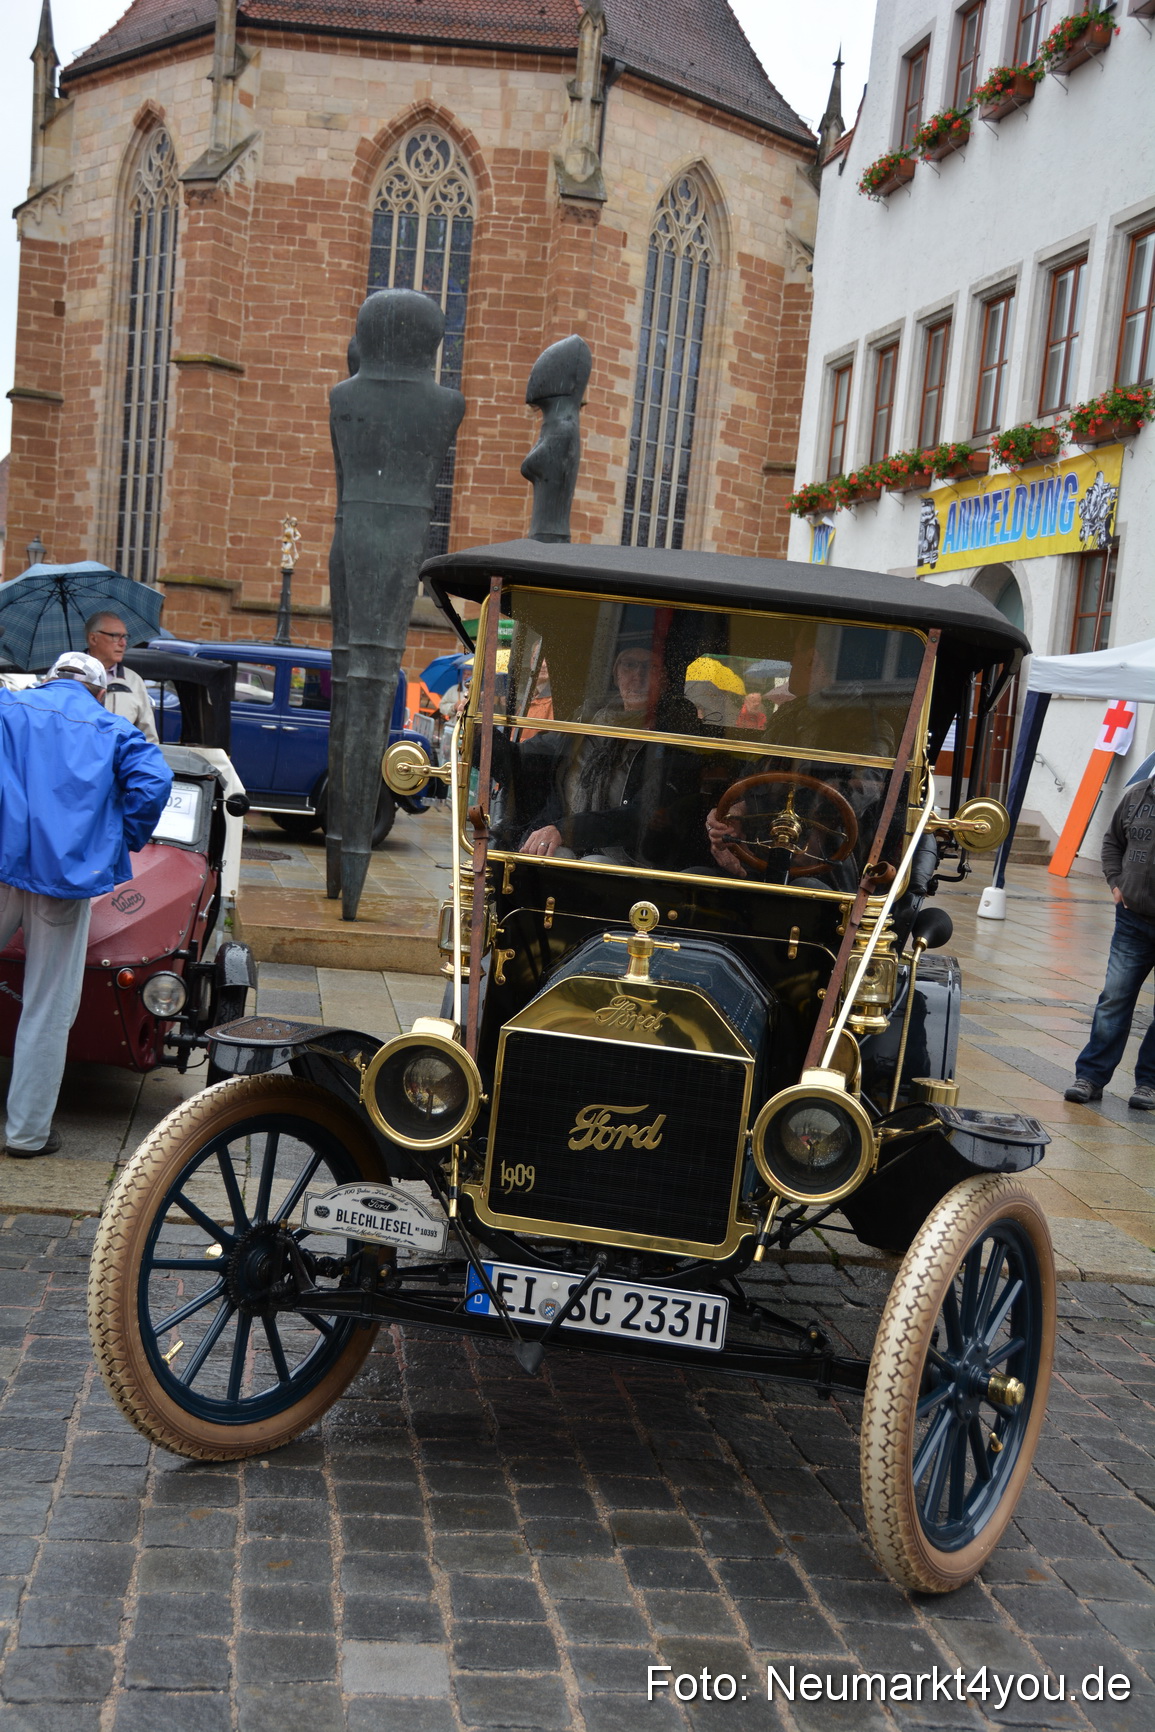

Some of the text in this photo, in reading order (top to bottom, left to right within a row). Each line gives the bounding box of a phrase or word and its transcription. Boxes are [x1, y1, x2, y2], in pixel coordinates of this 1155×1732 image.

[942, 471, 1080, 555] ANMELDUNG
[595, 995, 667, 1031] Ford
[567, 1104, 667, 1151] Ford
[500, 1160, 535, 1195] 1909
[367, 1198, 390, 1211] Ford
[336, 1209, 414, 1236] BLECHLIESEL
[420, 1228, 438, 1238] 10393
[474, 1294, 483, 1305] D
[497, 1271, 537, 1316] EI
[620, 1291, 721, 1343] 233H
